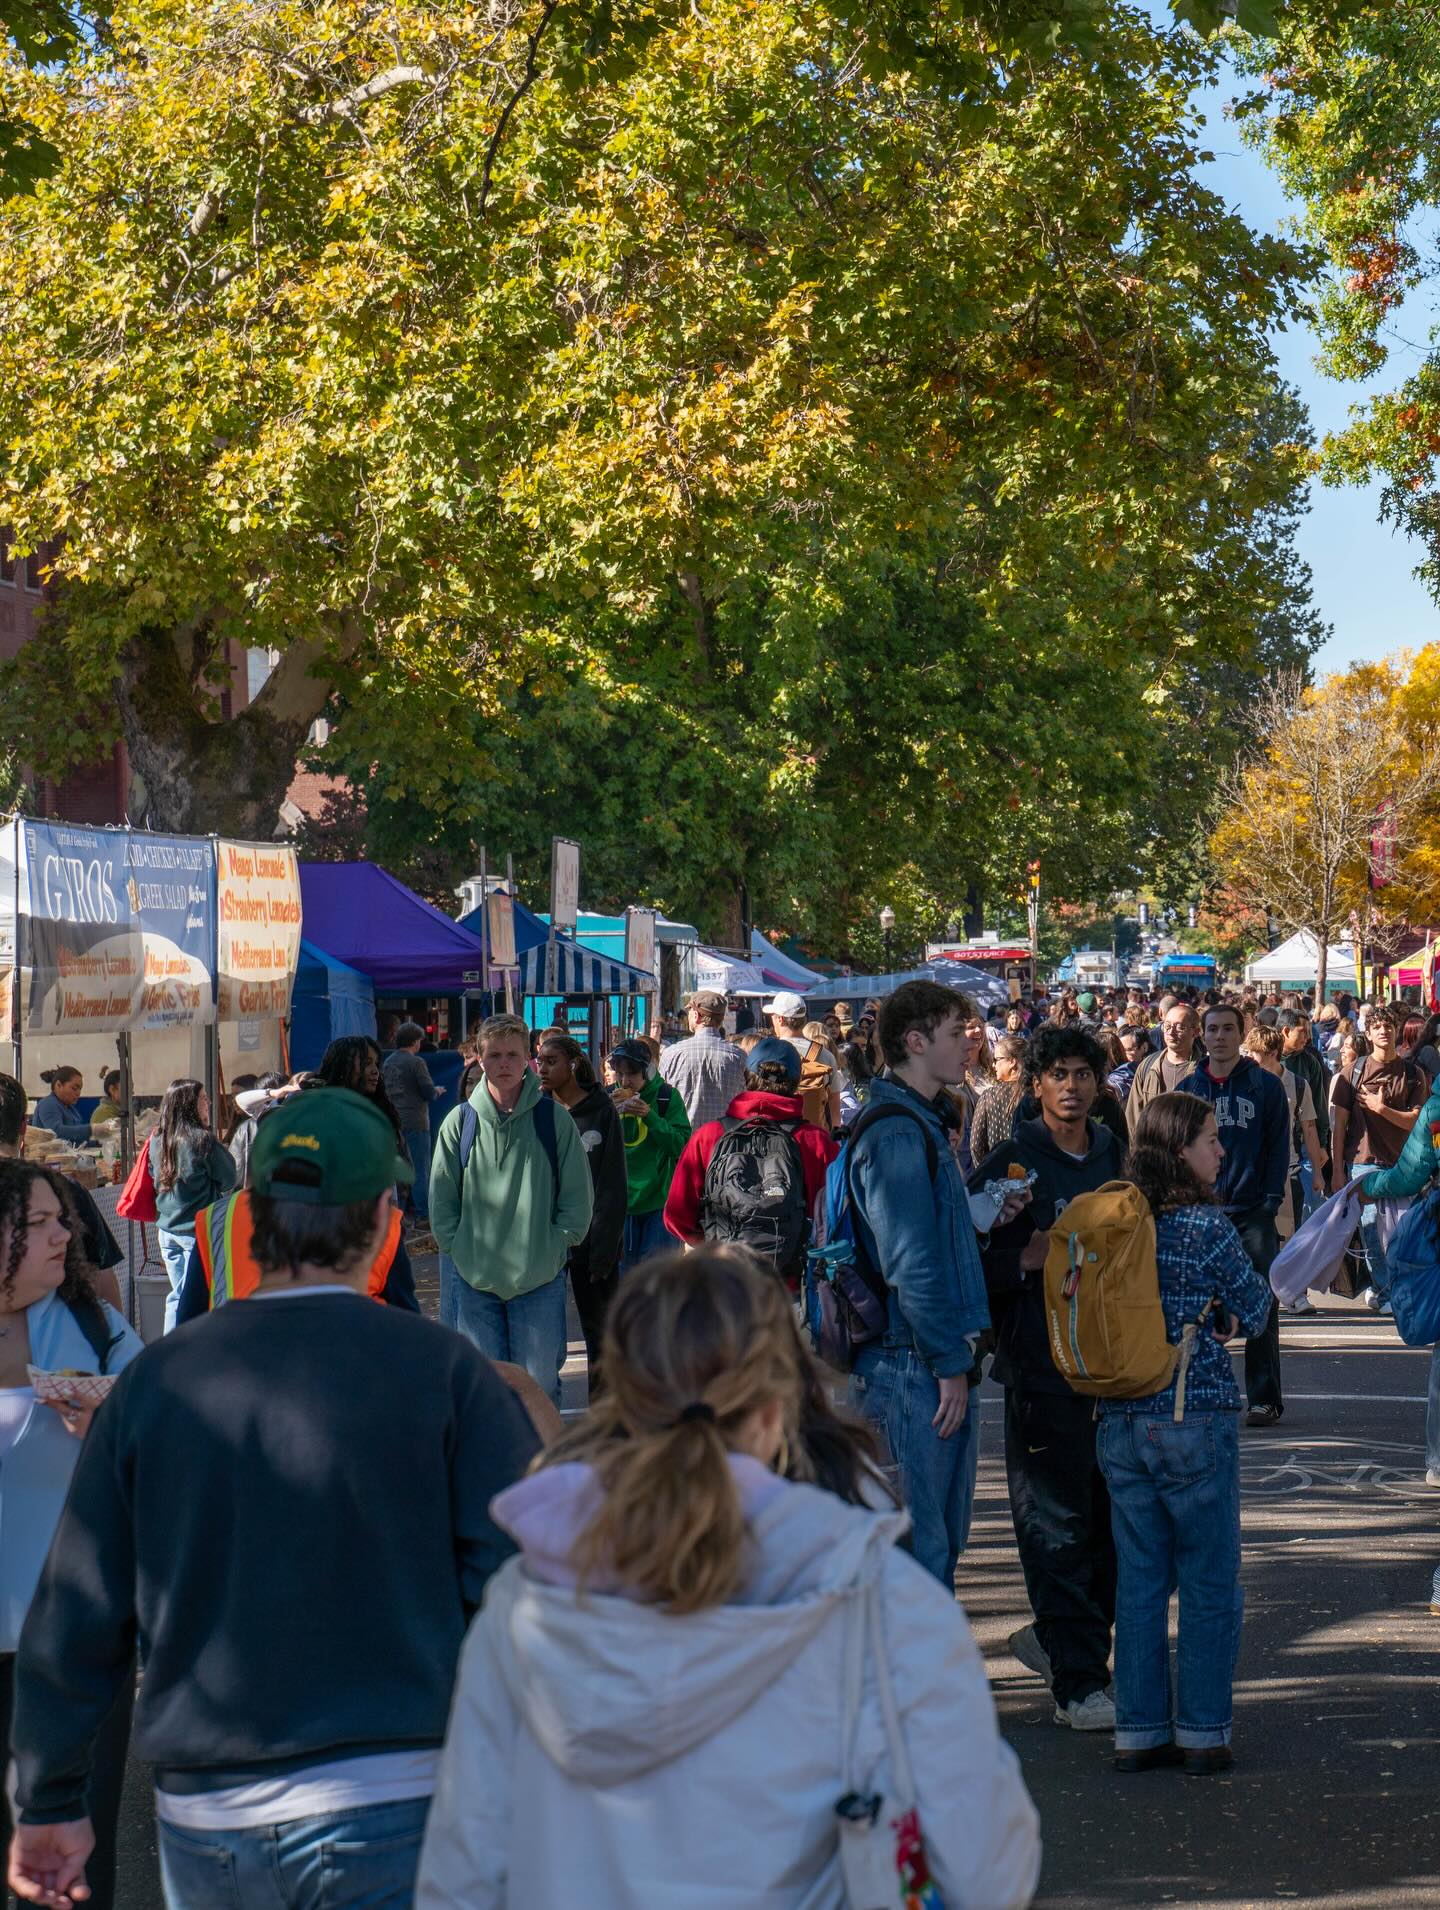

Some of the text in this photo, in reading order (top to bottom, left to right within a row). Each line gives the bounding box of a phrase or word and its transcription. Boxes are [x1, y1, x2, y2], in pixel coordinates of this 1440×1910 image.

[228, 847, 253, 884] Mango
[44, 854, 118, 924] GYROS
[139, 883, 163, 909] GREEK
[224, 889, 268, 929] Strawberry
[1215, 1095, 1256, 1129] AP
